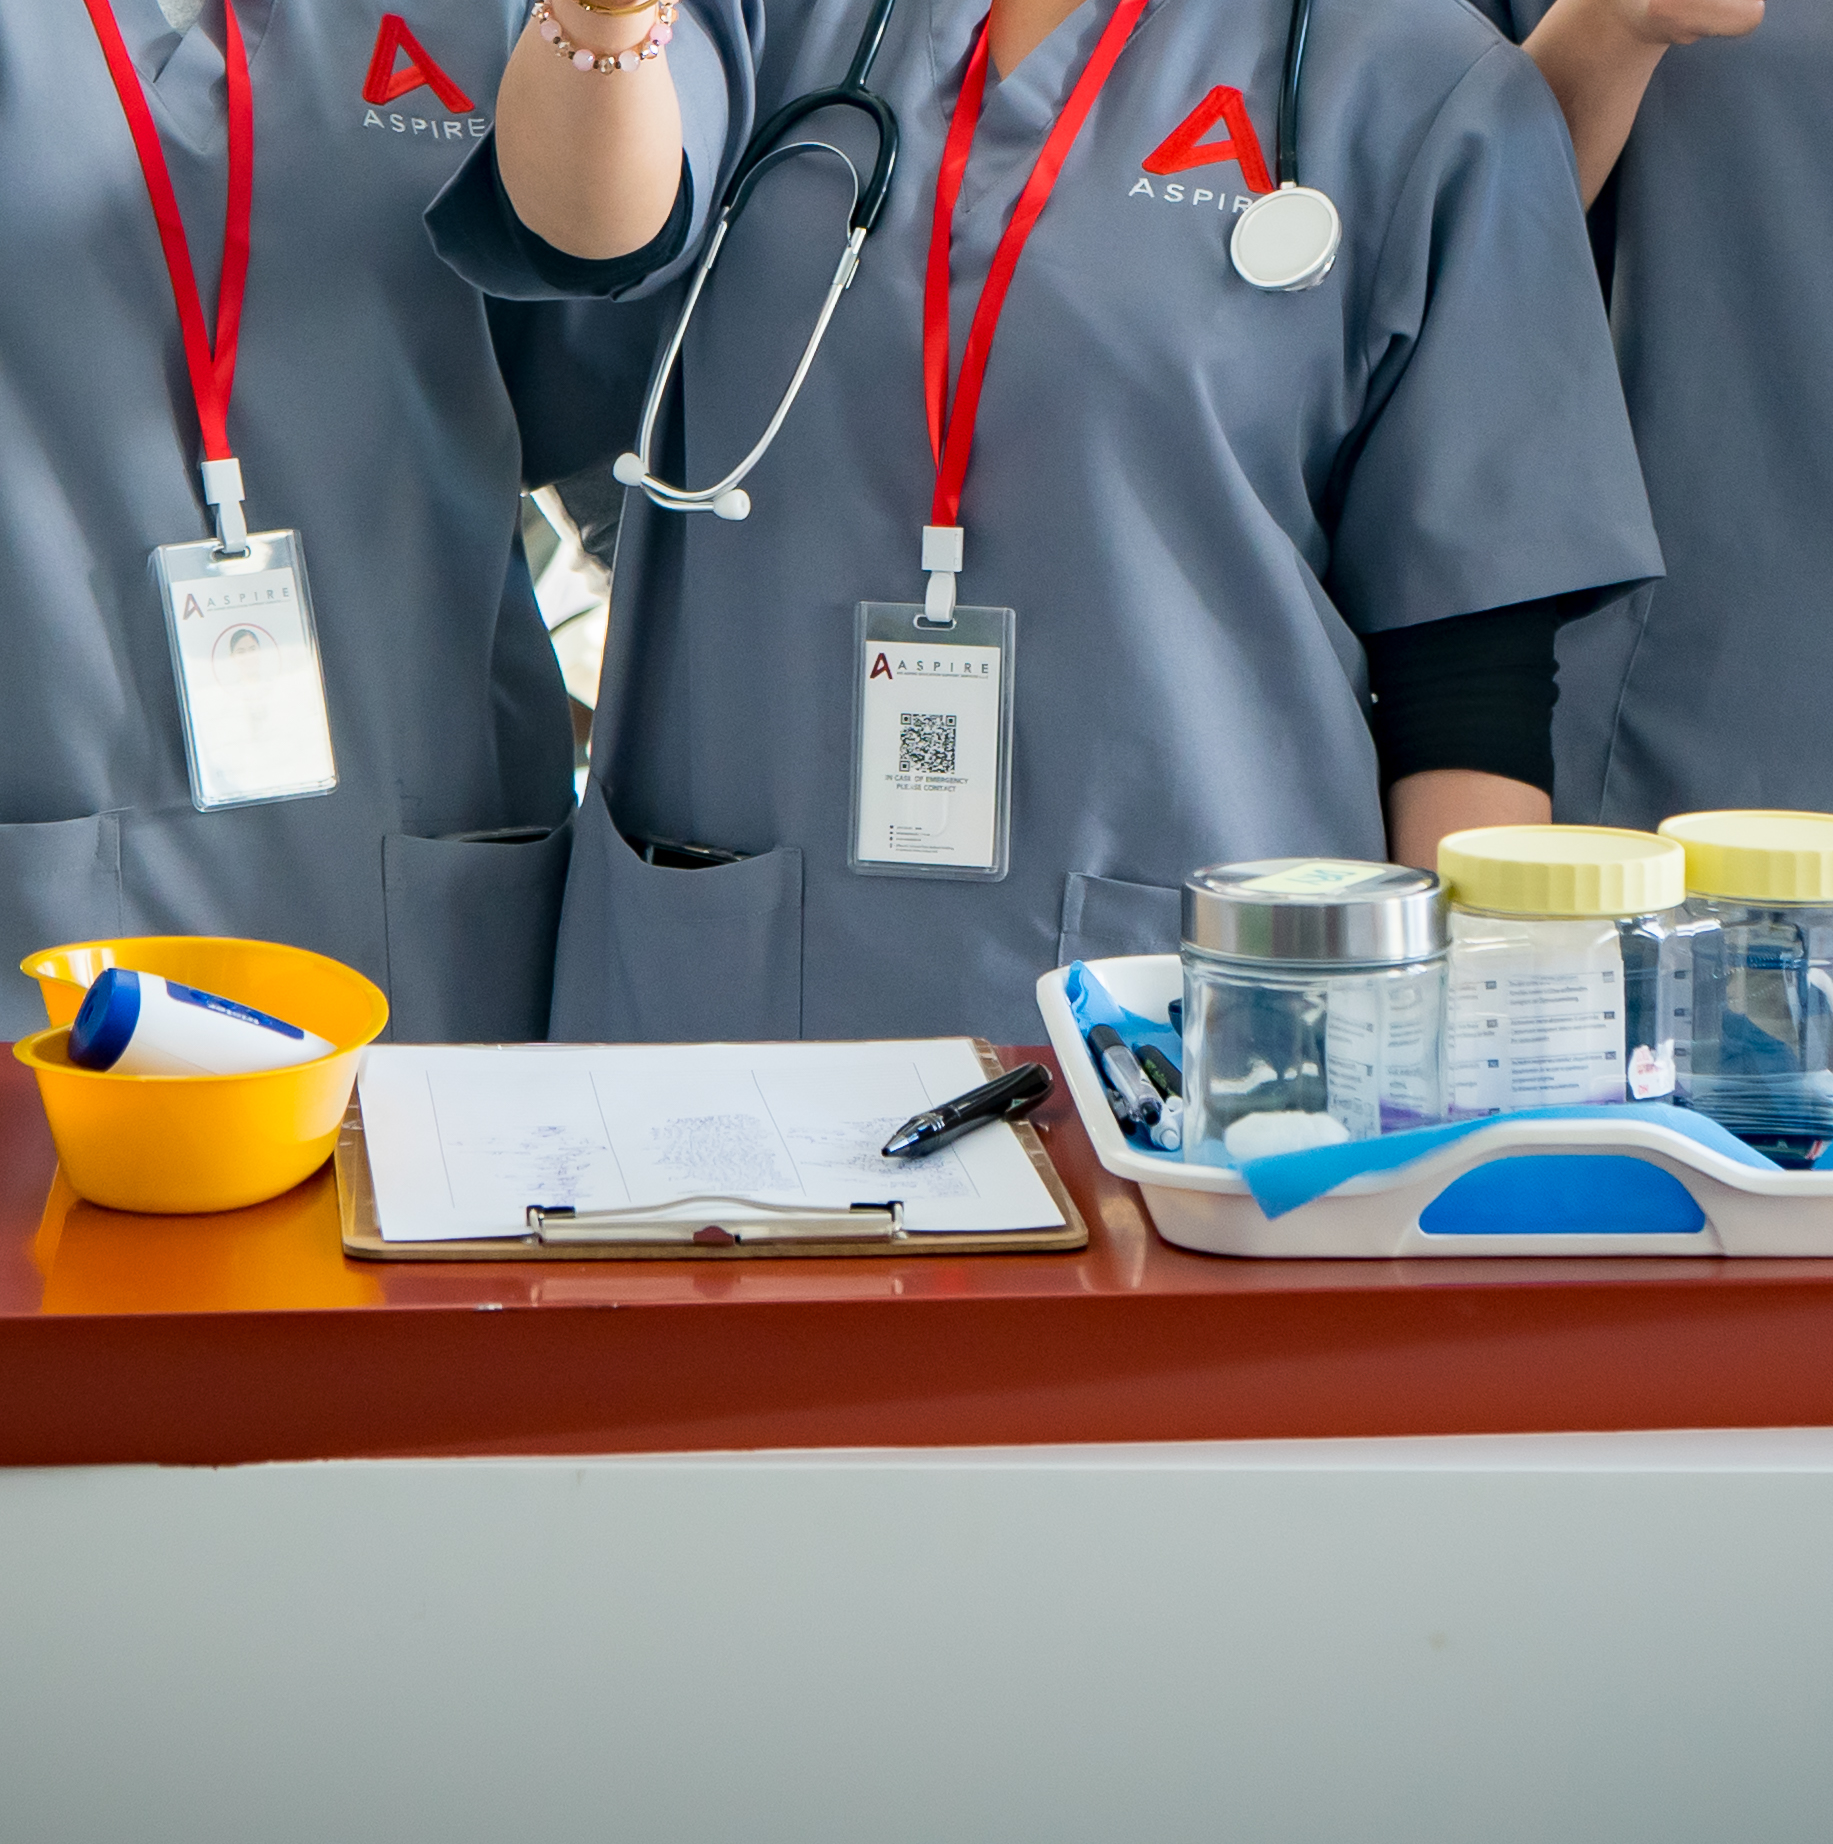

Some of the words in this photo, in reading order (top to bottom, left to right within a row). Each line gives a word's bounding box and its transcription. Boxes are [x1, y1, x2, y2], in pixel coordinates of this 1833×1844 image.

[363, 109, 486, 139] ASPIRE
[1128, 177, 1255, 213] ASPIR
[206, 587, 290, 607] ASPIRE
[897, 659, 989, 674] ASPIRE
